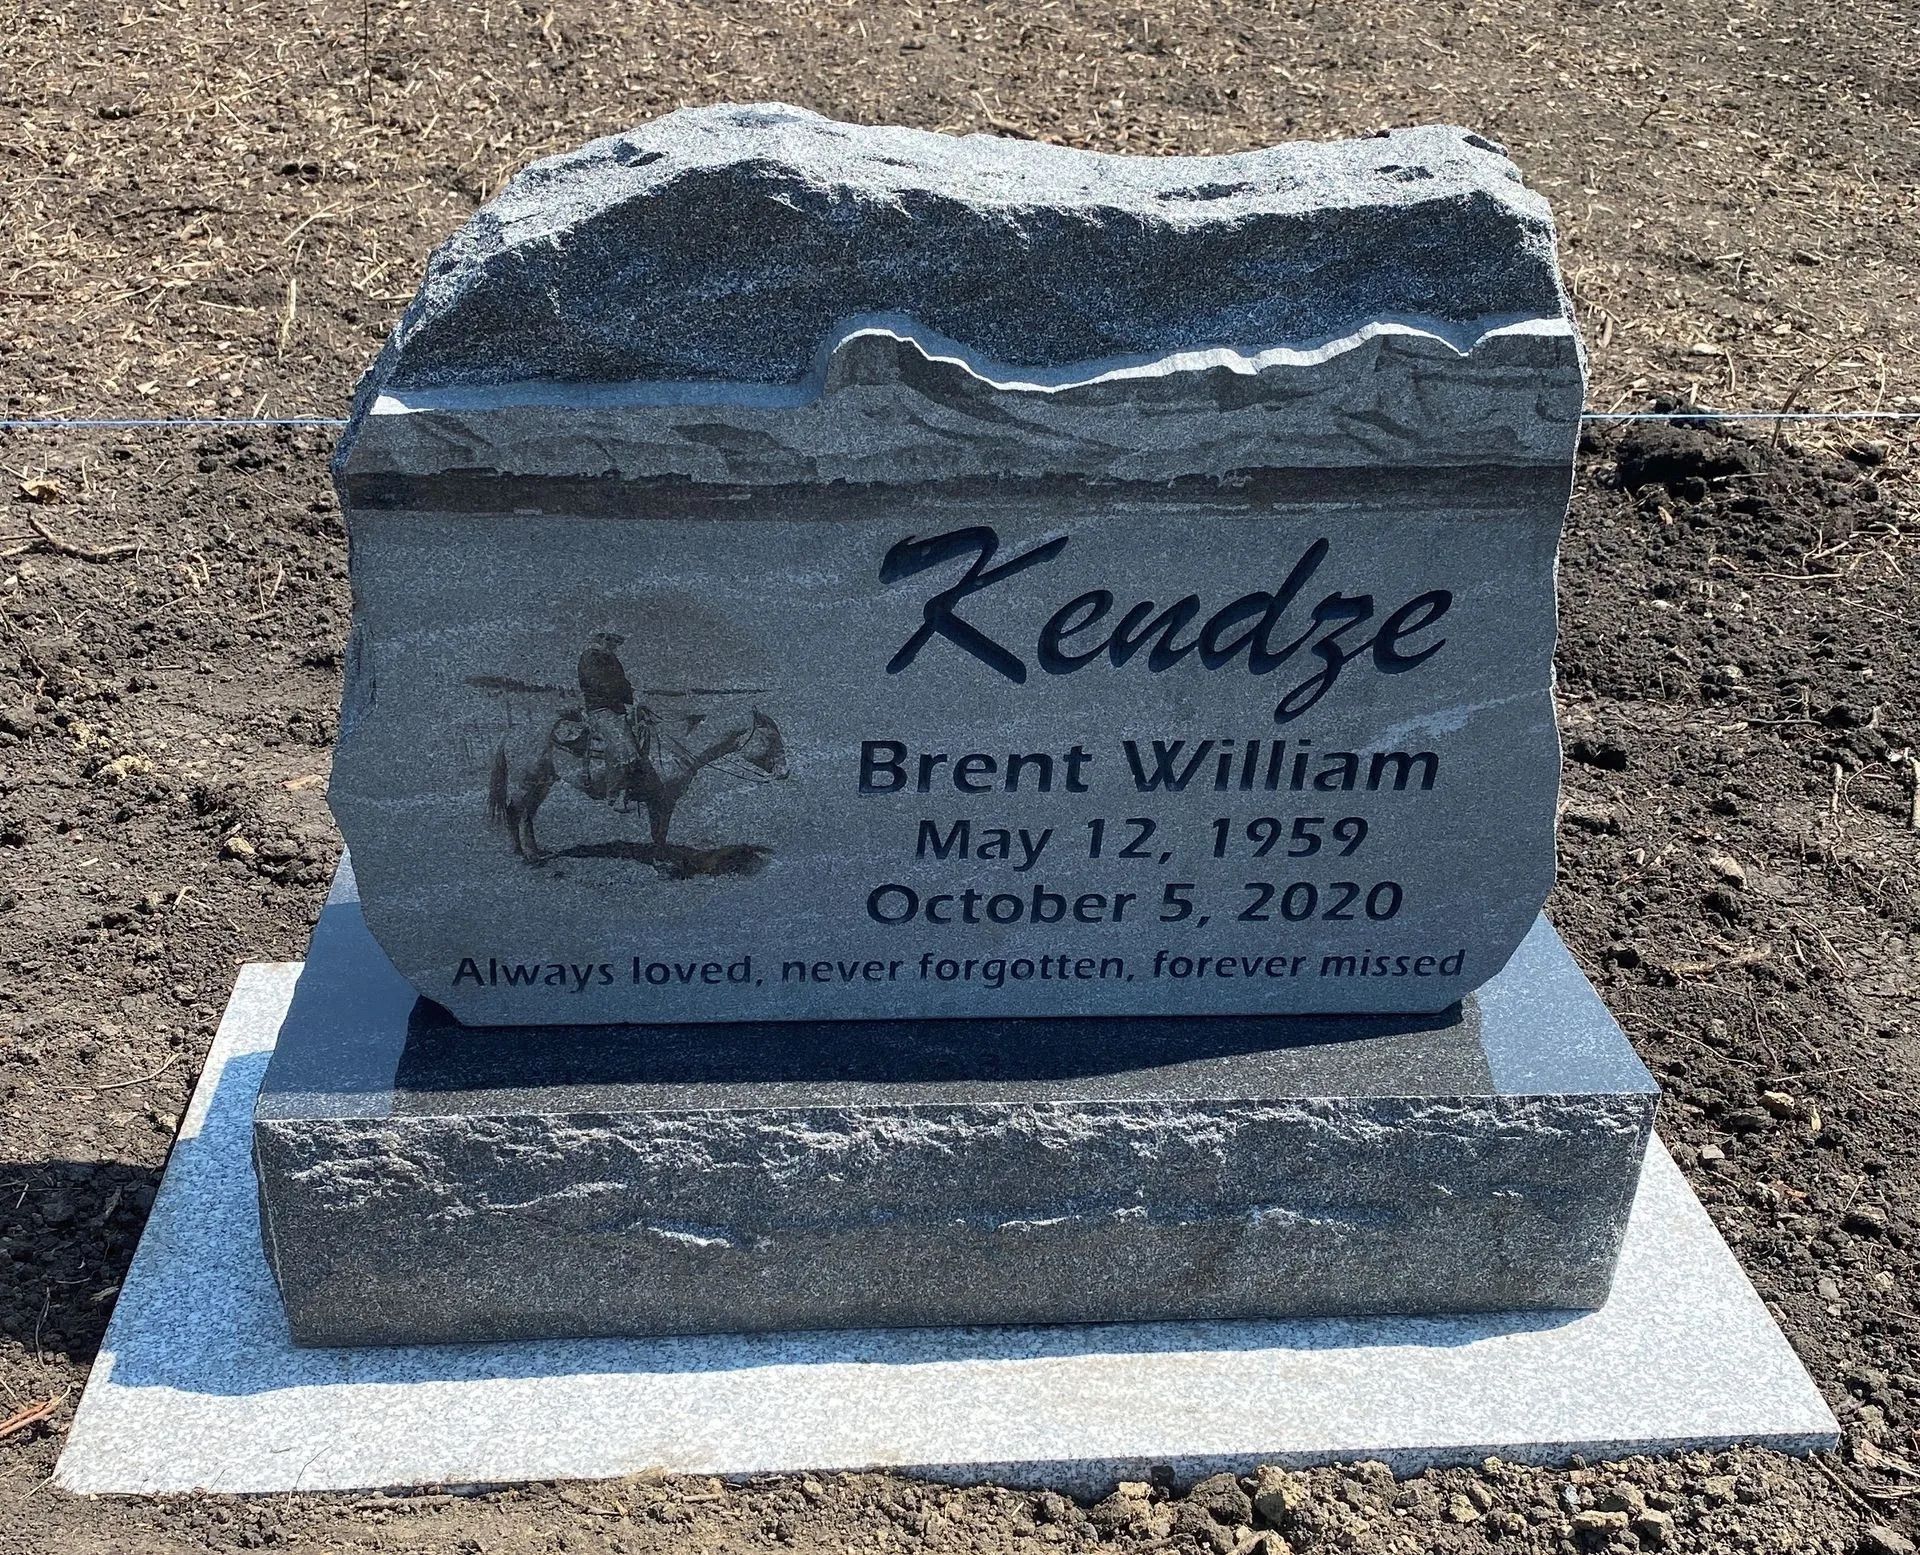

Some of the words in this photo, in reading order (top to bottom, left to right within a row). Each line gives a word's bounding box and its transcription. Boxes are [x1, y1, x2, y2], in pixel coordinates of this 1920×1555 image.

[879, 525, 1454, 724] Kendze
[858, 739, 1092, 795] Brent
[1123, 738, 1440, 793] William
[915, 819, 1053, 872] May
[1087, 817, 1173, 865] 12,
[1211, 817, 1369, 858] 1959
[866, 882, 1136, 925] October
[1158, 882, 1211, 928] 5,
[1237, 880, 1403, 922] 2020
[451, 956, 615, 994] Always
[632, 955, 764, 989] loved,
[782, 958, 903, 983] never
[919, 952, 1135, 989] forgotten,
[1153, 949, 1307, 980] forever
[1319, 947, 1466, 978] missed
